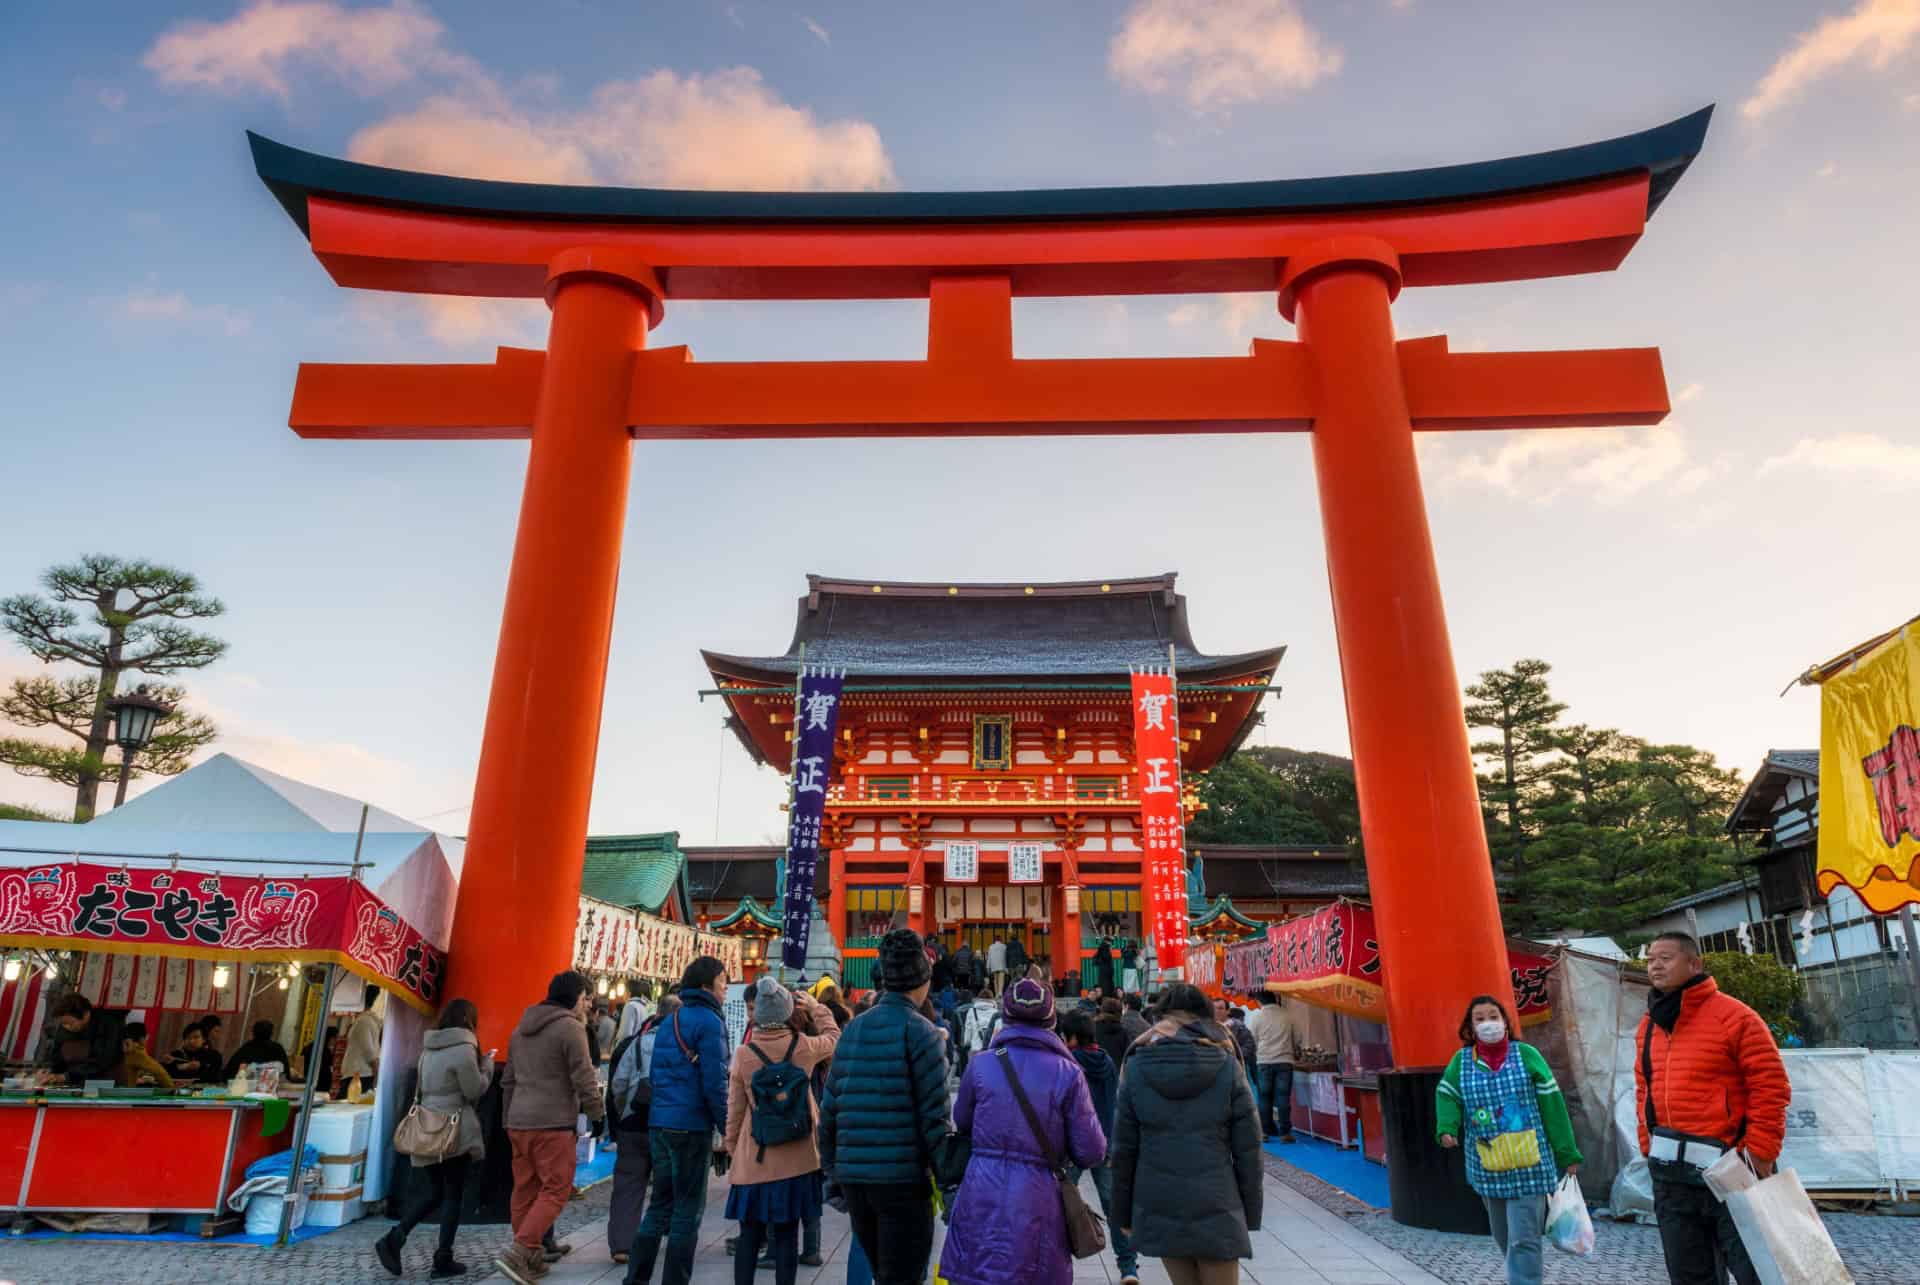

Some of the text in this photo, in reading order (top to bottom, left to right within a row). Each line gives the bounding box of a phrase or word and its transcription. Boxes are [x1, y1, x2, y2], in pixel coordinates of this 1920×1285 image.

[798, 690, 836, 793] 賀正
[1138, 689, 1174, 794] 賀正
[106, 872, 220, 893] 味自慢
[73, 883, 237, 944] たこやき
[398, 941, 445, 1001] たこ
